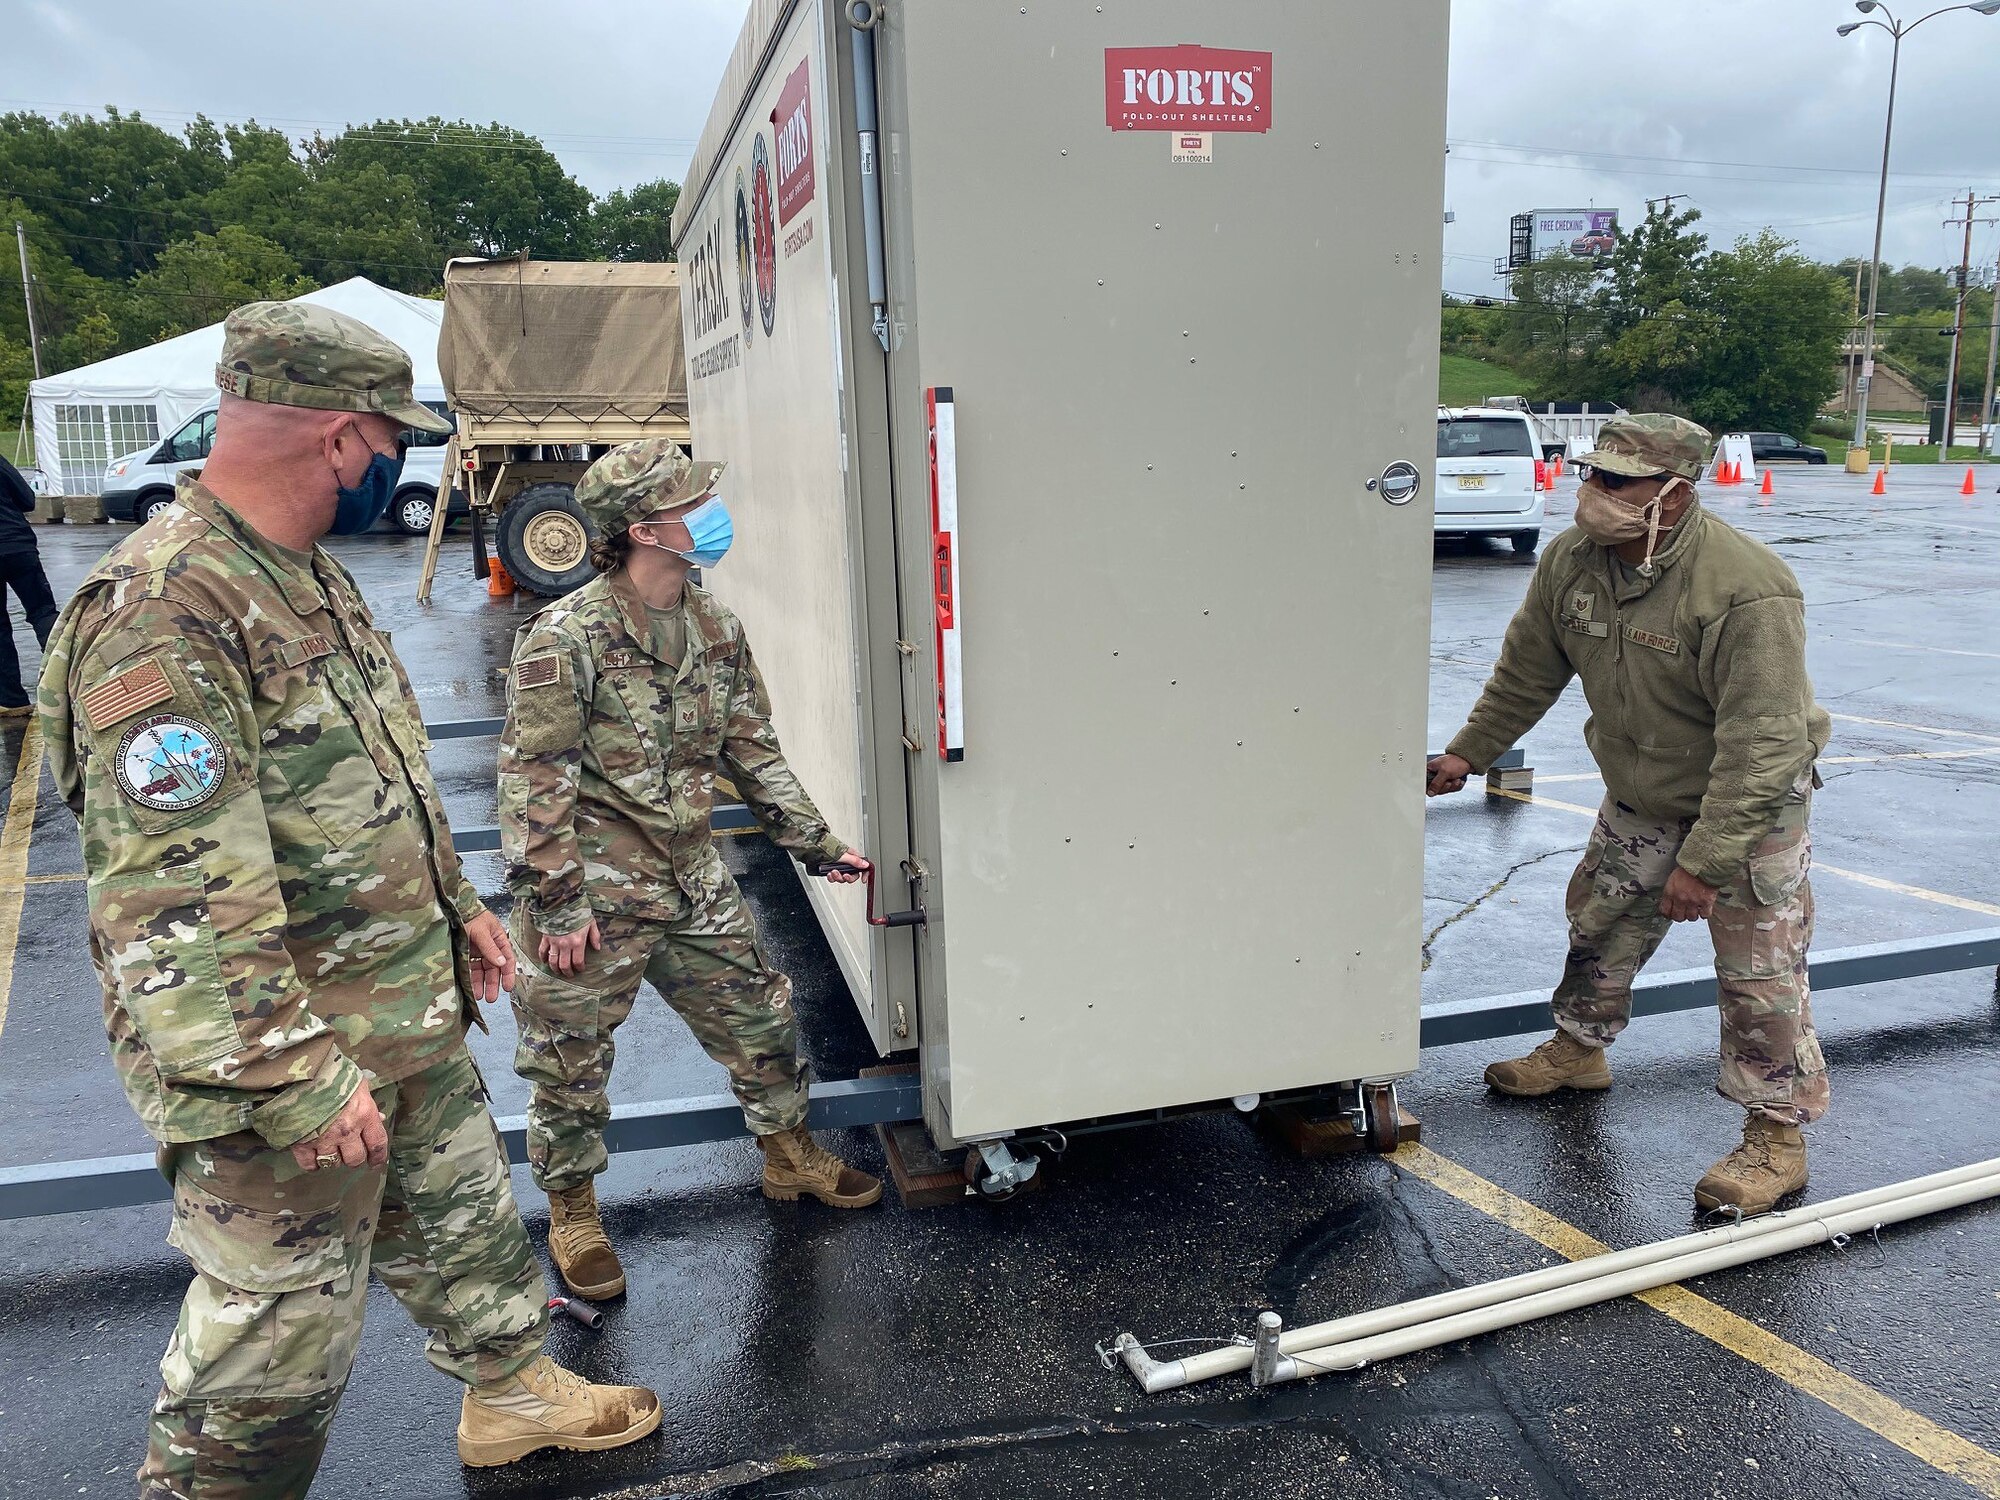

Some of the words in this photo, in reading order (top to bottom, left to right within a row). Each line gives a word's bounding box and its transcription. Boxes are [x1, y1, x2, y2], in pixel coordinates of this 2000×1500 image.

[1122, 68, 1254, 106] FORTS
[1122, 112, 1185, 121] FOLD-OUT
[1192, 113, 1253, 122] SHELTERS
[778, 98, 808, 186] FORTS
[1540, 220, 1554, 231] FREE
[1555, 219, 1583, 231] CHECKING
[1647, 632, 1677, 652] FORCE
[174, 715, 204, 732] MEDICAL
[117, 740, 130, 770] SUPPORT
[204, 730, 224, 759] AIRCRAFT
[118, 771, 137, 797] MISSION
[200, 760, 225, 800] MAINTENANCE
[138, 796, 185, 809] OPERATIONS
